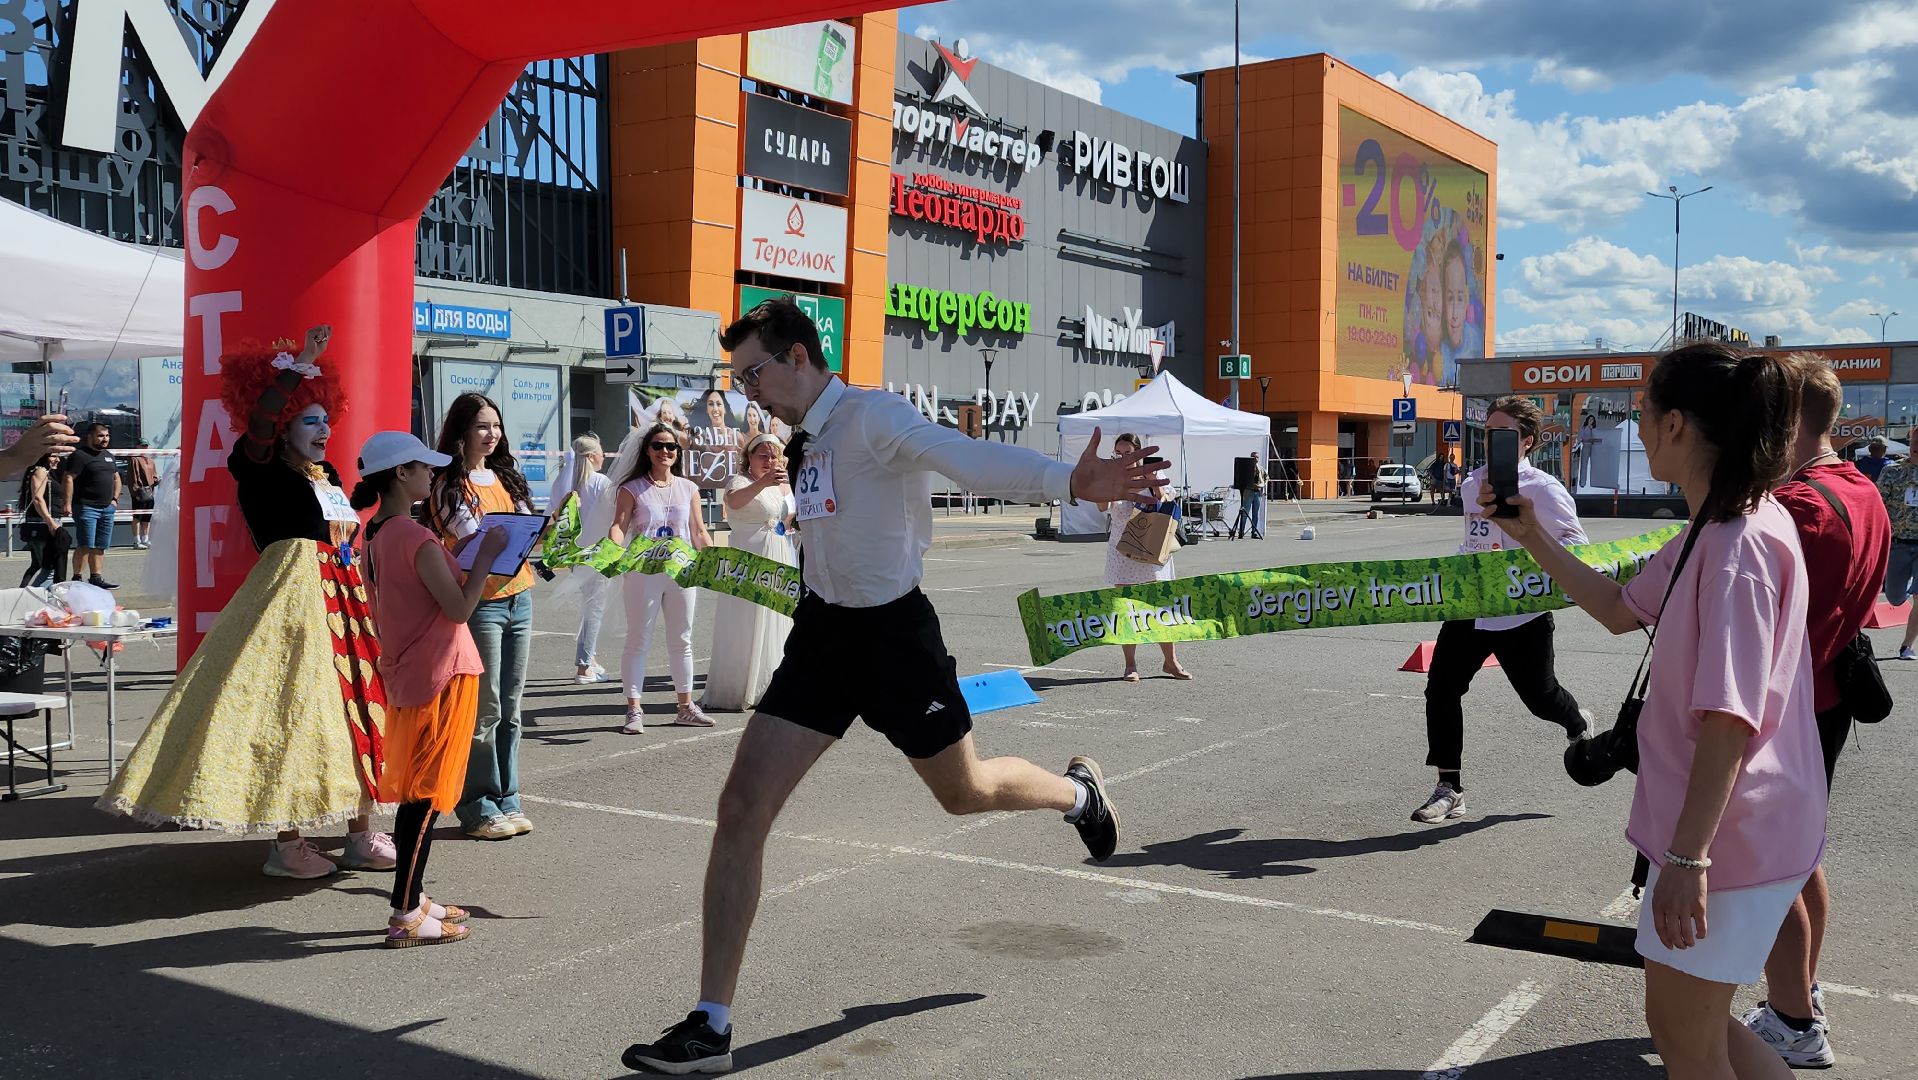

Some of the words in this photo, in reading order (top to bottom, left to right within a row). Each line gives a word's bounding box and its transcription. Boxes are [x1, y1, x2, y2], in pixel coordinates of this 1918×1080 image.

[764, 128, 830, 166] СУДАРЬ
[1074, 130, 1132, 188] РИВ
[1137, 150, 1190, 204] ГОШ
[752, 237, 836, 273] Теремок
[1347, 261, 1365, 284] НА
[1366, 265, 1400, 292] БИЛЕТ
[414, 309, 429, 327] Ы
[433, 308, 462, 331] ДЛЯ
[466, 310, 508, 334] ВОДЫ
[613, 312, 634, 352] P
[161, 358, 183, 370] Ана
[1225, 360, 1234, 374] 8
[1523, 364, 1591, 384] ОБОИ
[1601, 363, 1643, 382] marburg
[1829, 357, 1881, 371] МАНИИ
[169, 375, 183, 385] во
[450, 373, 478, 385] Осмос
[479, 375, 495, 387] для
[513, 378, 533, 389] Соль
[534, 380, 550, 391] для
[511, 389, 552, 404] фильтров
[186, 184, 242, 633] СТАР
[1398, 400, 1412, 419] P
[693, 426, 741, 446] ЗАБЕГ
[799, 466, 820, 494] 32
[1469, 520, 1490, 537] 25
[1247, 580, 1357, 625] Sergiev
[1369, 572, 1444, 608] trail
[1126, 595, 1196, 633] trail
